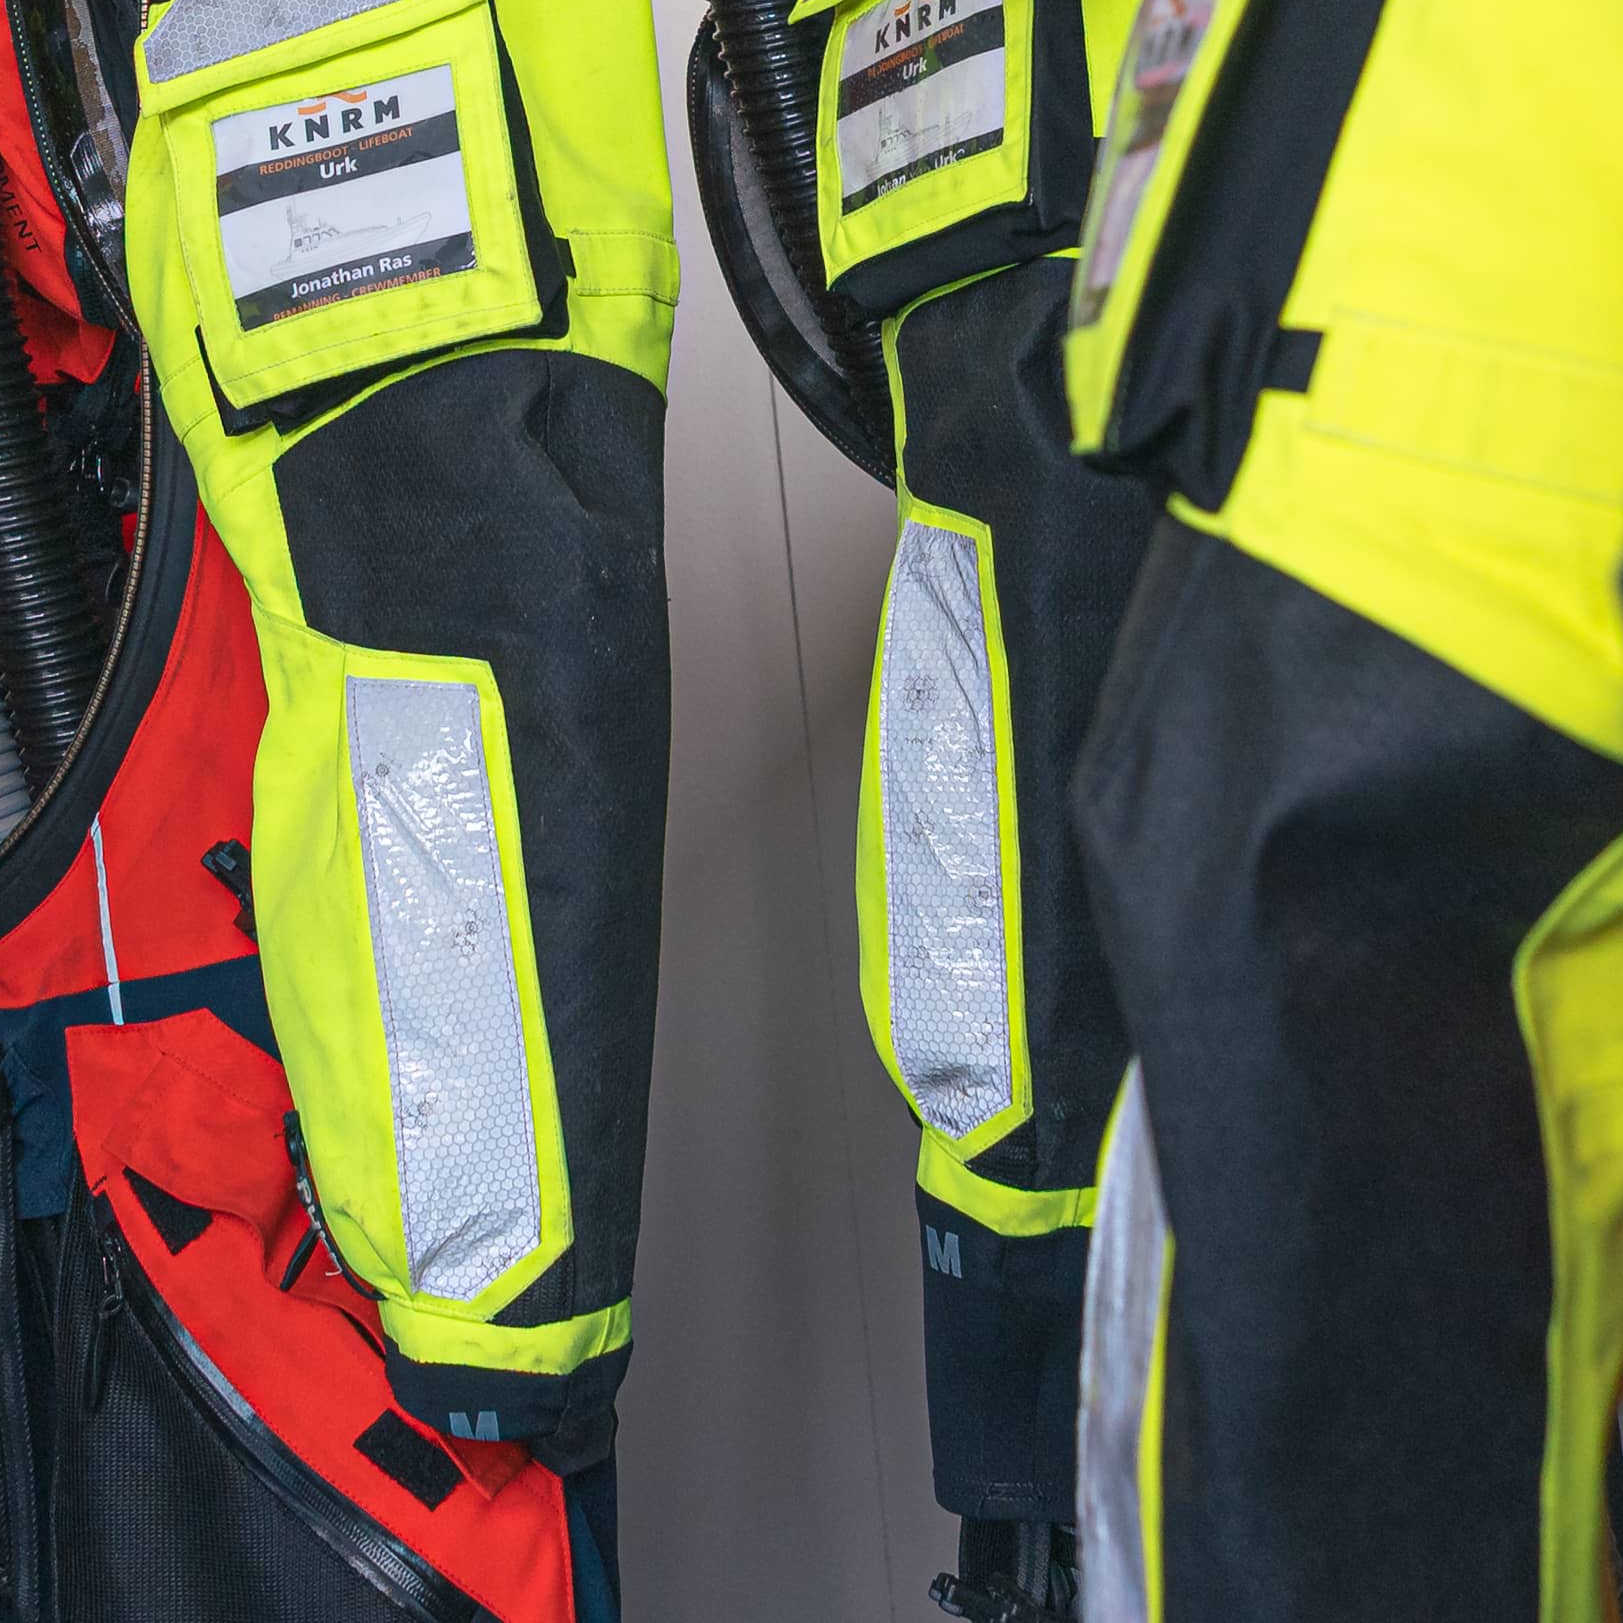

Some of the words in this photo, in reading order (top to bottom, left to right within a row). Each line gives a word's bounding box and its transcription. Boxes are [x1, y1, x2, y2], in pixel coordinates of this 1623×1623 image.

[903, 55, 928, 81] Urk
[269, 95, 401, 151] KNRM
[259, 146, 349, 176] REDDINGBOOT
[359, 127, 414, 152] LIFEBOAT
[319, 157, 359, 179] Urk
[290, 264, 374, 299] Jonathan
[379, 253, 413, 274] Ras
[351, 267, 442, 299] CREWMEMBER
[926, 1225, 962, 1279] M
